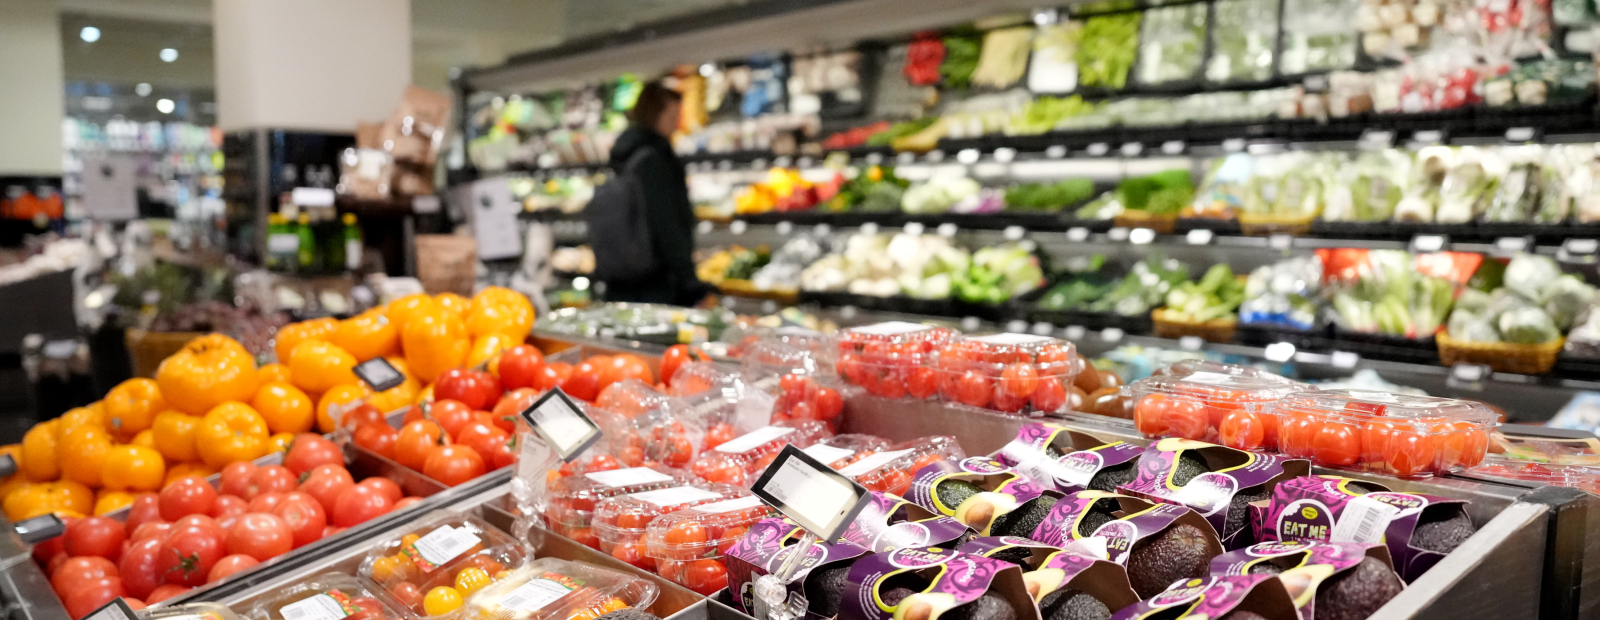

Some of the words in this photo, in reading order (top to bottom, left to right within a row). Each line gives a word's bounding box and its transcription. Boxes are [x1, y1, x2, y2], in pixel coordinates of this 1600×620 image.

[1283, 520, 1309, 537] EAT
[1308, 525, 1327, 539] ME
[1107, 537, 1129, 550] EAT
[898, 548, 928, 557] EAT
[923, 553, 946, 561] ME
